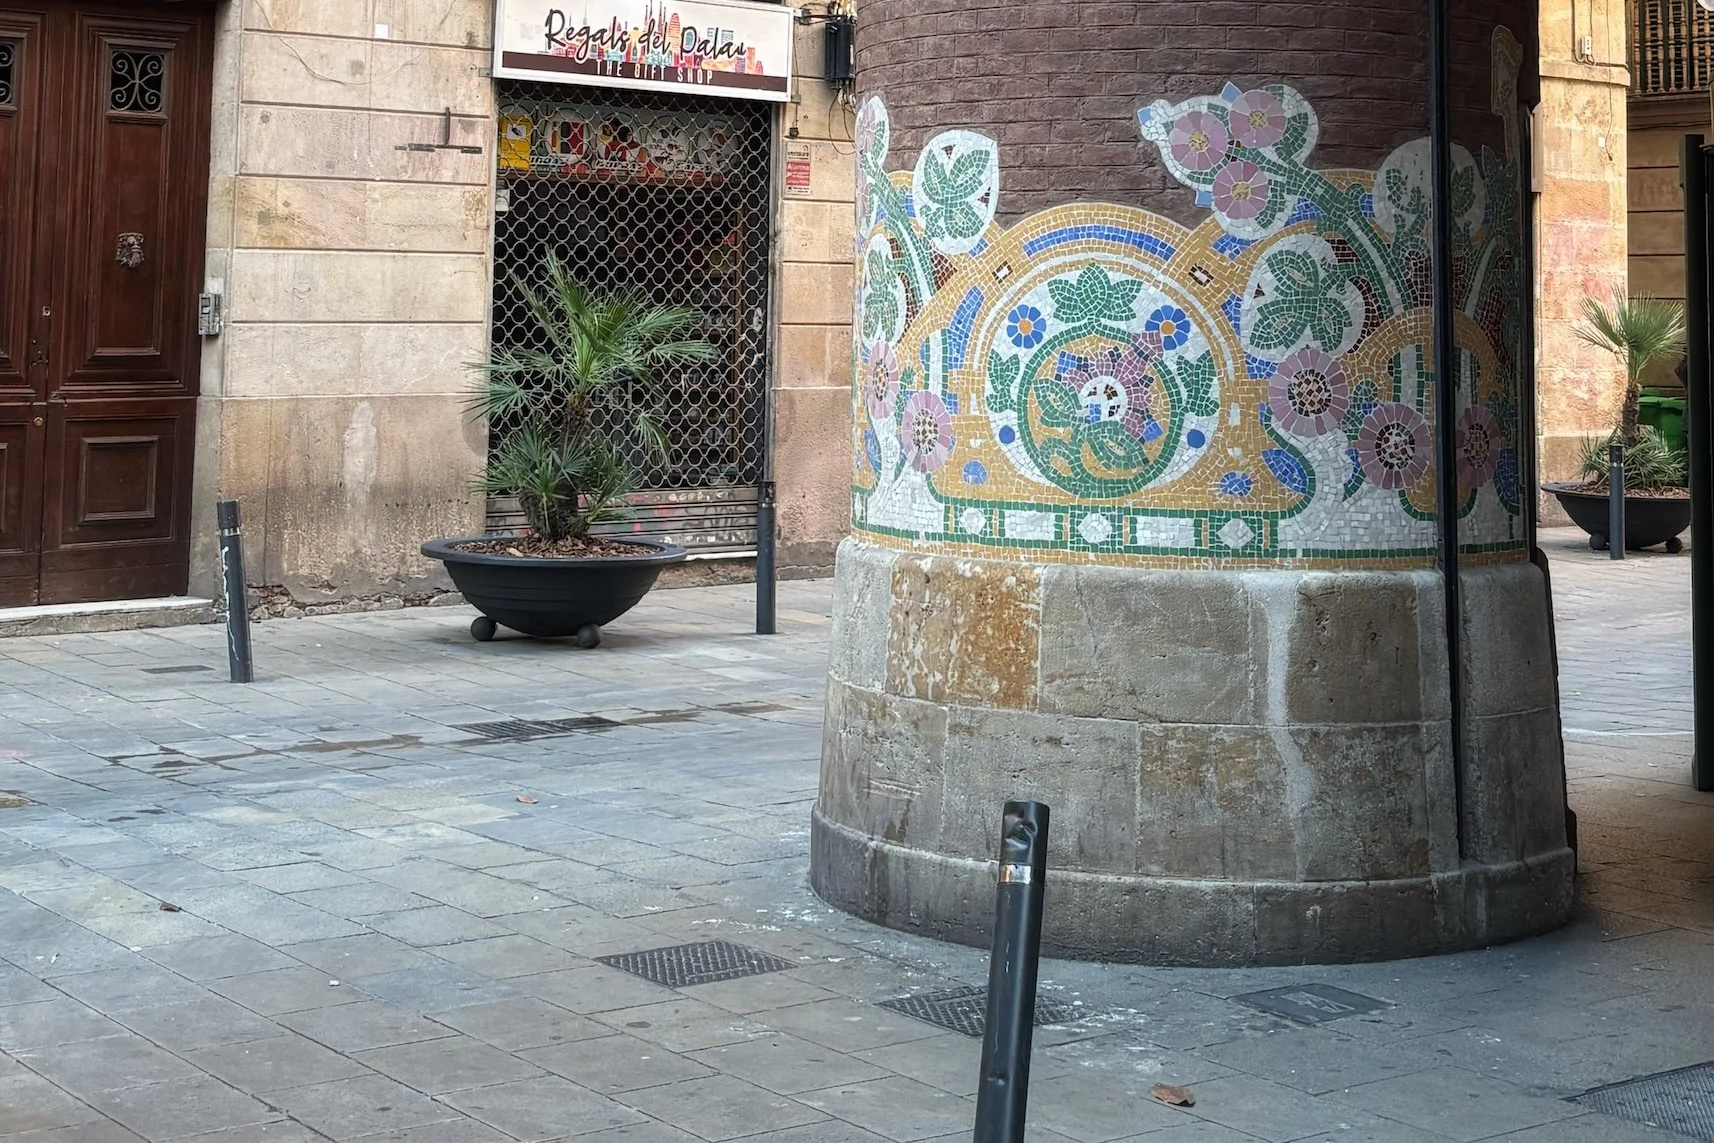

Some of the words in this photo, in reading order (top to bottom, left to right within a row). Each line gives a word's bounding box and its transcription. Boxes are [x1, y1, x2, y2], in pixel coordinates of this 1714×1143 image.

[544, 8, 630, 62] Regals
[638, 18, 671, 56] del
[680, 26, 747, 62] Palau
[596, 59, 622, 77] THE
[634, 63, 666, 81] GIFT
[677, 66, 713, 85] SHOP
